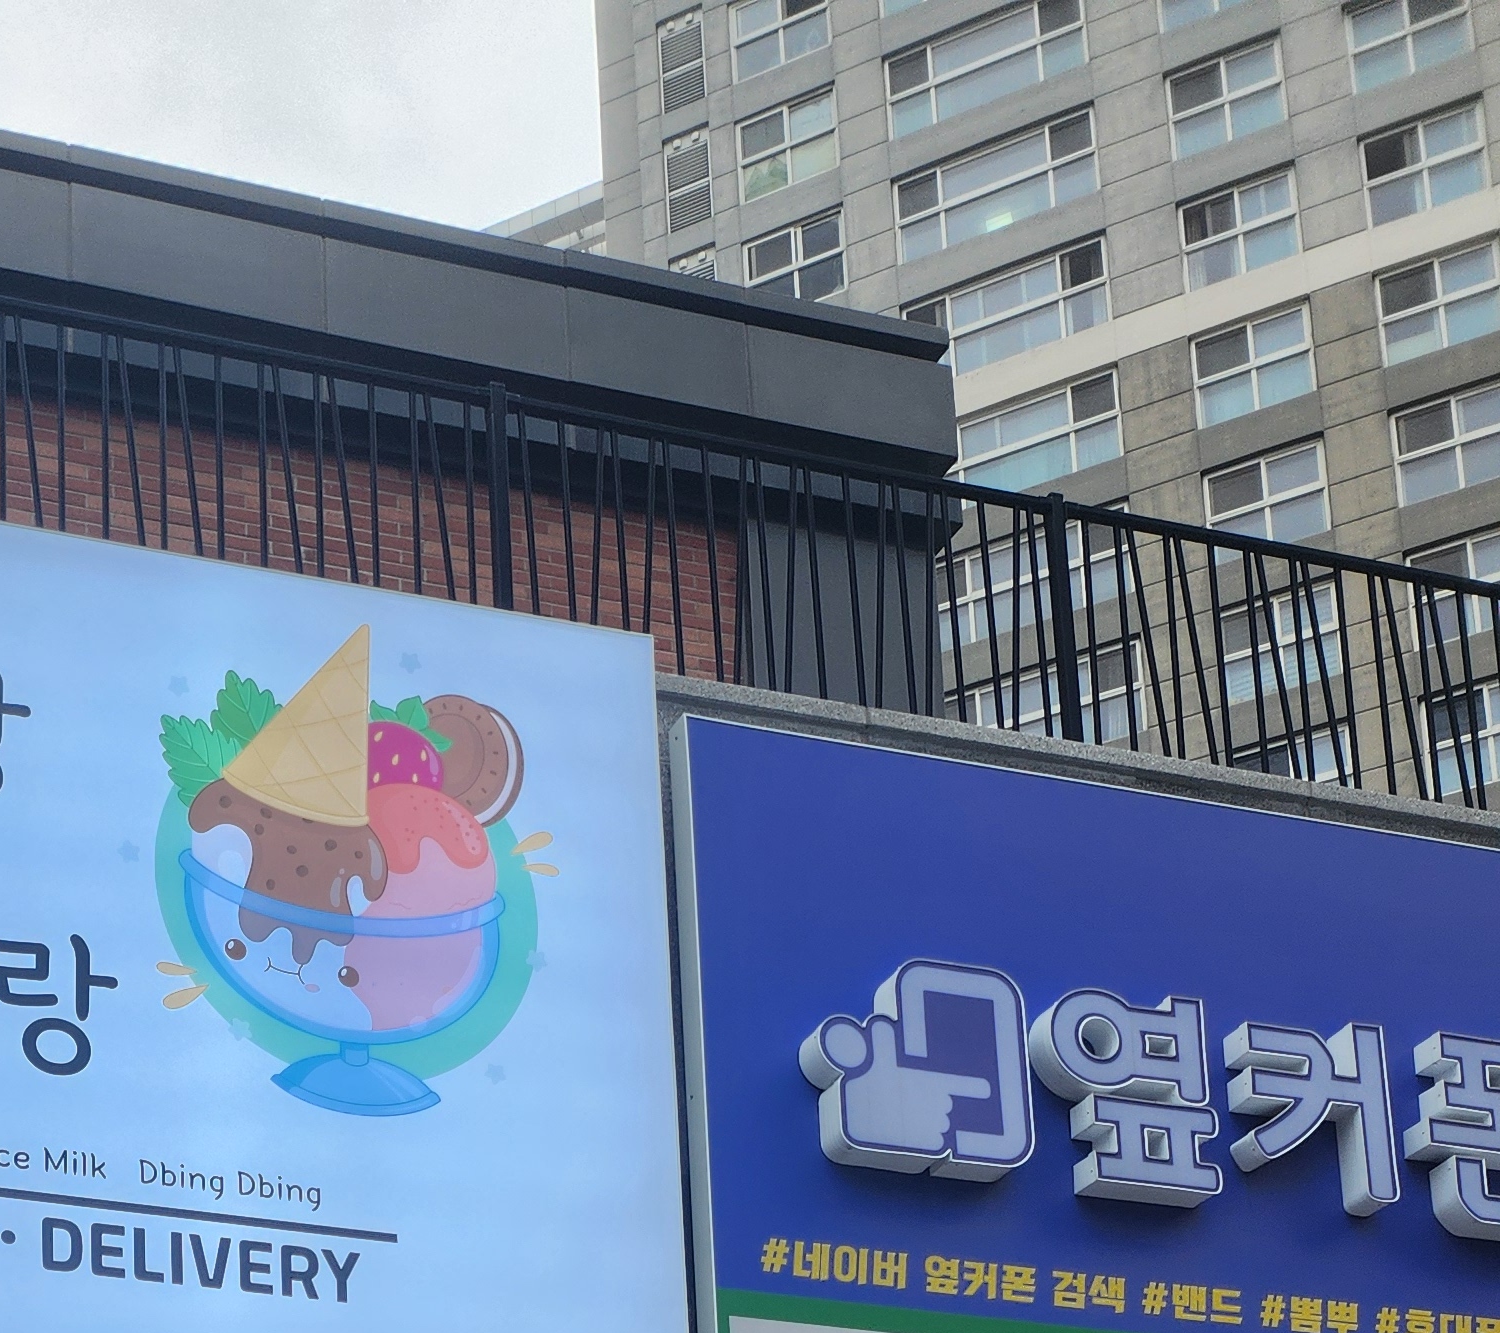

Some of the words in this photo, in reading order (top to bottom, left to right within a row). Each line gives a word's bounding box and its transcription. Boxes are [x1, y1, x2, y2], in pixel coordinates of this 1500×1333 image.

[43, 1146, 107, 1181] Milk
[139, 1158, 225, 1201] Dbing
[237, 1171, 322, 1212] Dbing
[40, 1216, 361, 1304] DELIVERY
[760, 1237, 908, 1290] #네이버
[924, 1253, 1037, 1305] 옆커폰
[1050, 1269, 1127, 1314] 검색
[1141, 1281, 1243, 1326] #밴드
